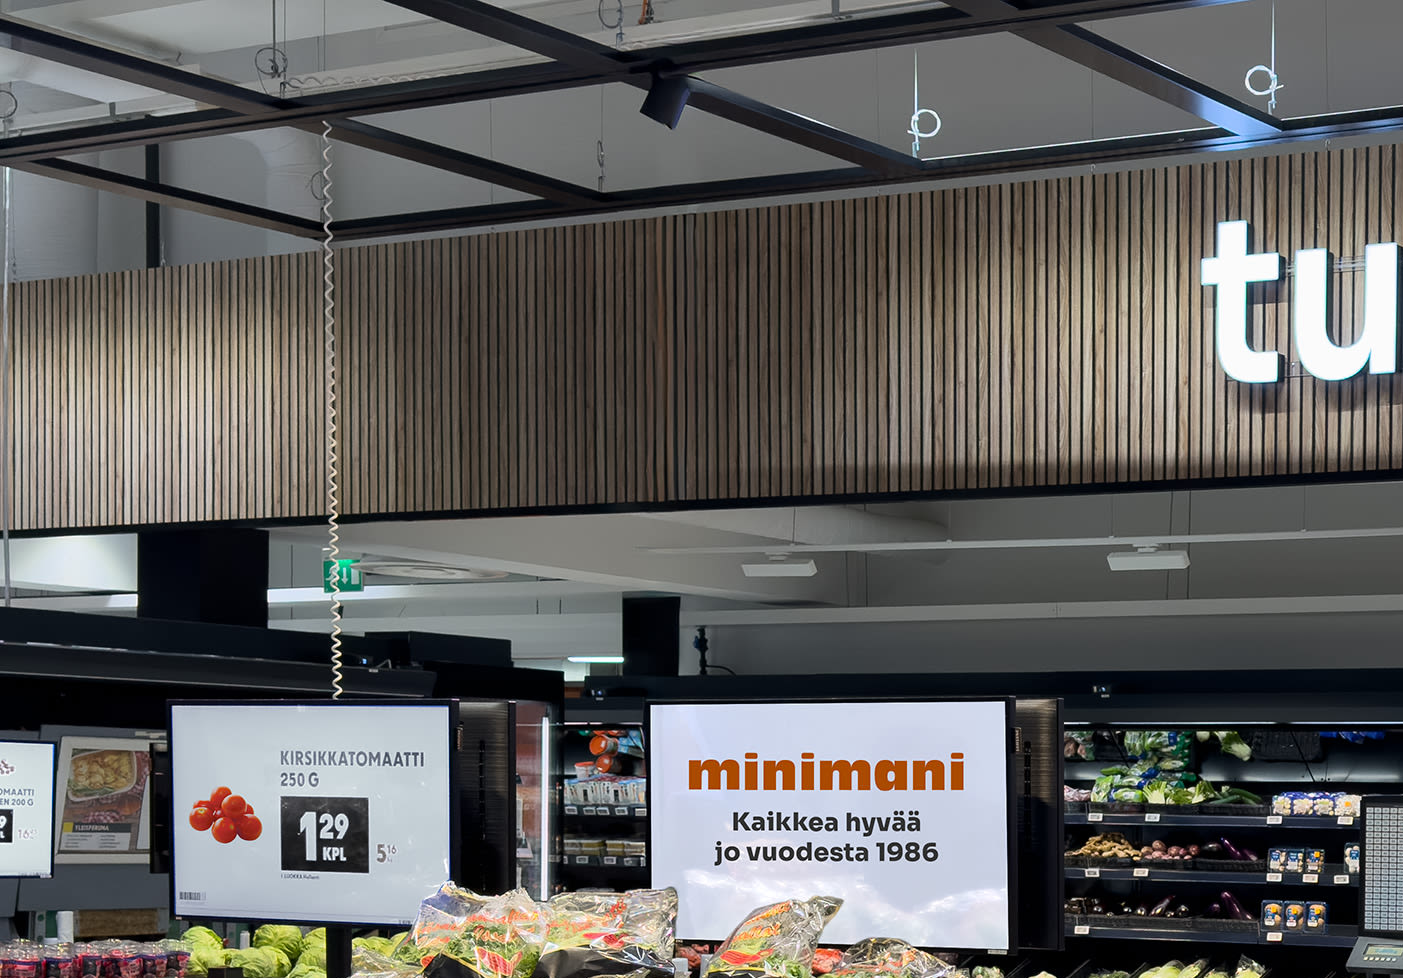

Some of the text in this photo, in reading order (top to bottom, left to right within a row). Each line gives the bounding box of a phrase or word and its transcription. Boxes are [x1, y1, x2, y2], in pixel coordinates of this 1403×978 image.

[280, 750, 425, 767] KIRSIKKATOMAATTI
[280, 771, 320, 787] 250 G
[688, 752, 964, 792] minimani
[11, 798, 26, 806] 200
[27, 798, 34, 806] G
[732, 810, 921, 837] Kaikkea hyvää
[299, 811, 350, 862] 1 29
[322, 846, 347, 862] KPL
[376, 843, 387, 863] 5
[714, 840, 939, 867] jo vuodesta 1986
